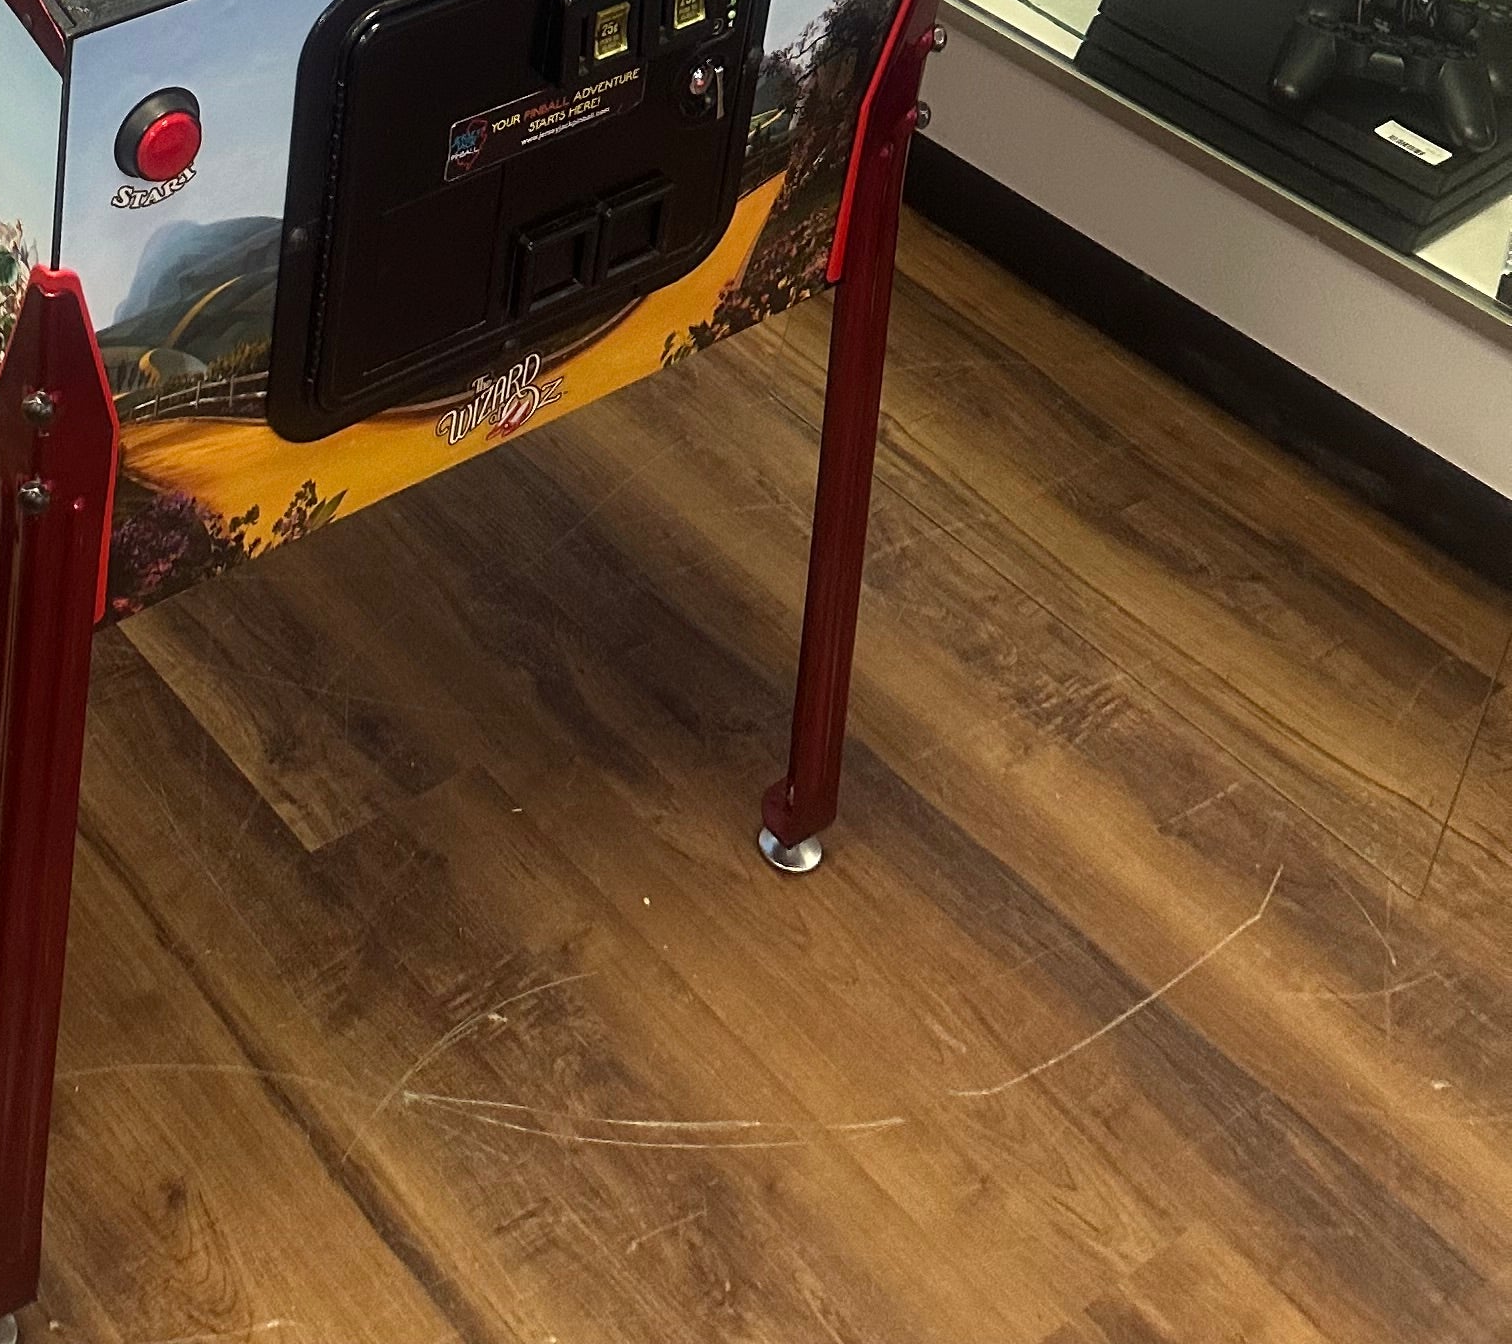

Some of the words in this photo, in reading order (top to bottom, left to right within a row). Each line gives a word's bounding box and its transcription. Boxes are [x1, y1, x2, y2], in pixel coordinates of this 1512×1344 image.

[491, 112, 521, 135] YOUR
[522, 95, 570, 123] PINBALL
[572, 67, 641, 103] ADVENTURE
[527, 109, 567, 133] STARTS
[568, 96, 603, 119] HERE!
[110, 162, 197, 209] START
[436, 352, 542, 446] WIZARD
[471, 373, 495, 395] The
